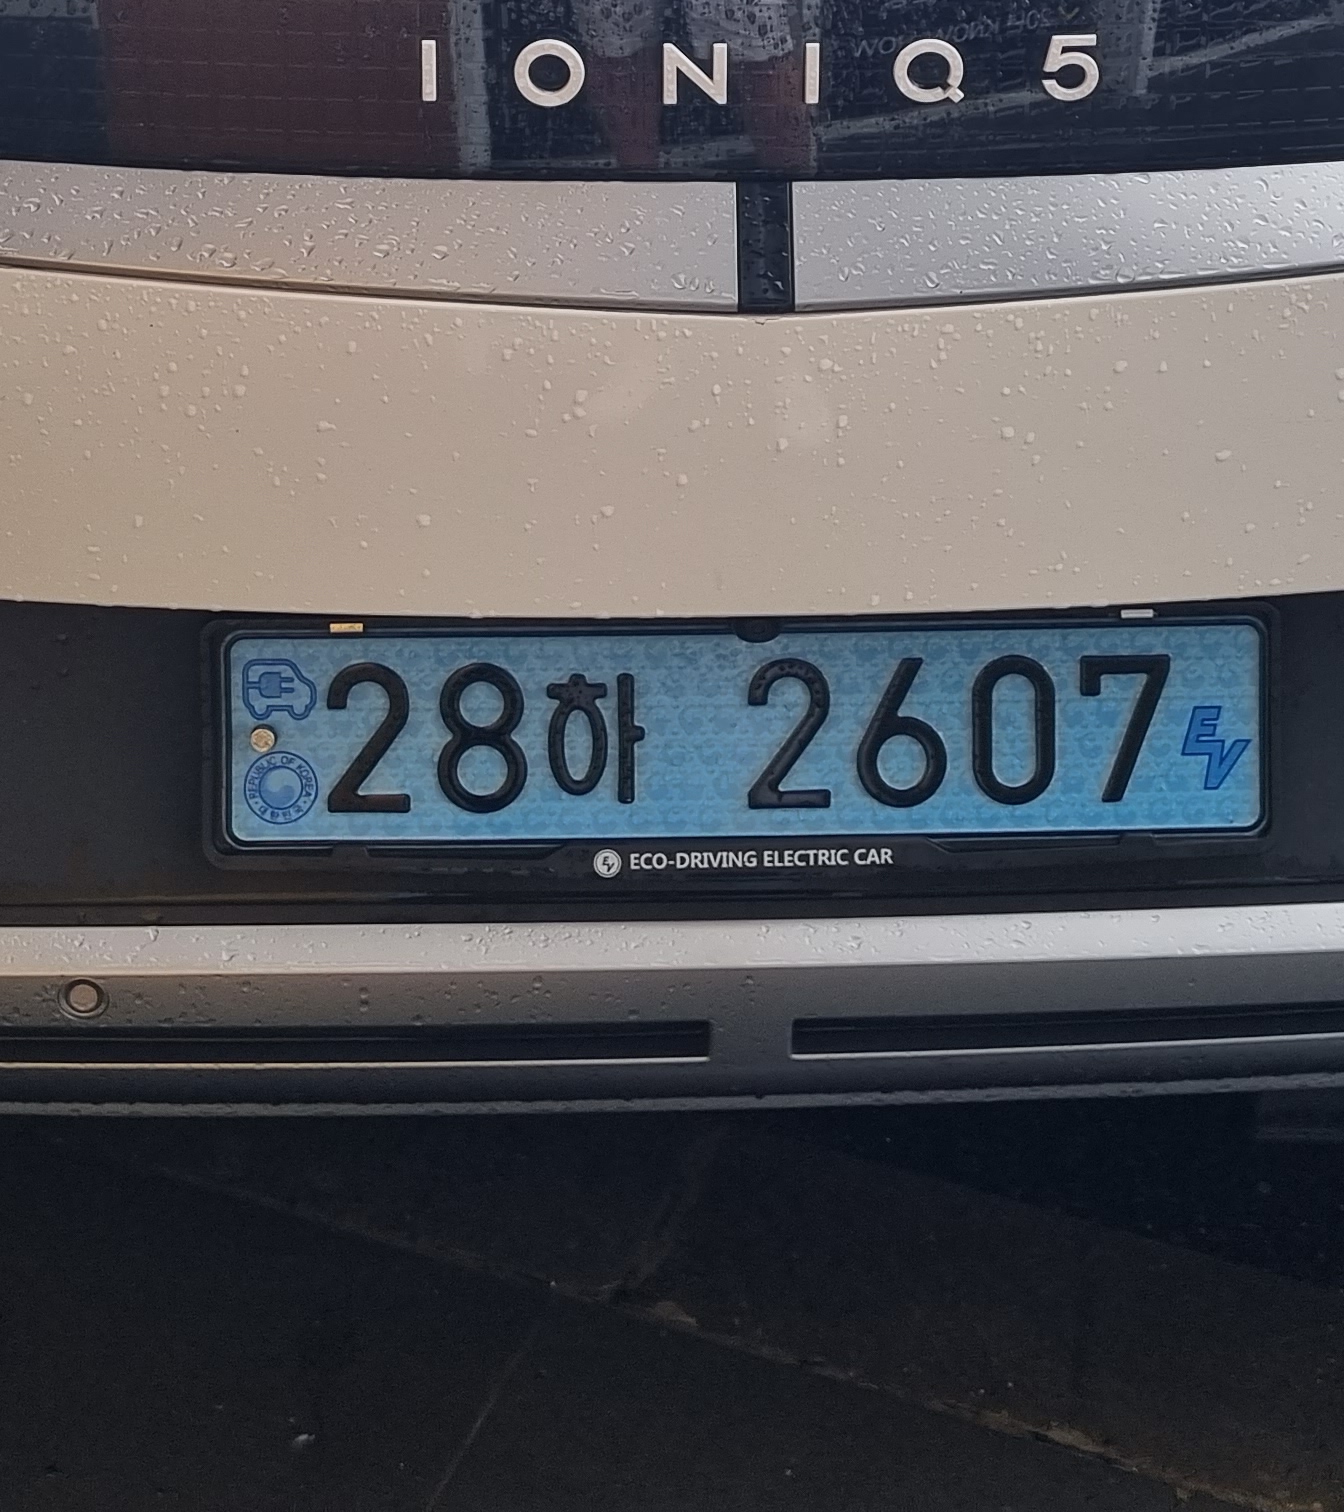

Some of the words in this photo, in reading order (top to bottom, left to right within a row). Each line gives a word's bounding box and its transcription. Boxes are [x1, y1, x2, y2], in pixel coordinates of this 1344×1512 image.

[326, 661, 646, 814] 28하
[747, 653, 1171, 809] 2607
[1181, 705, 1253, 790] EV
[247, 756, 277, 799] REPUBLIC
[280, 755, 296, 766] OF
[296, 763, 315, 798] KOREA
[629, 850, 758, 870] ECO-DRIVING
[763, 848, 850, 868] ELECTRIC
[853, 848, 895, 865] CAR
